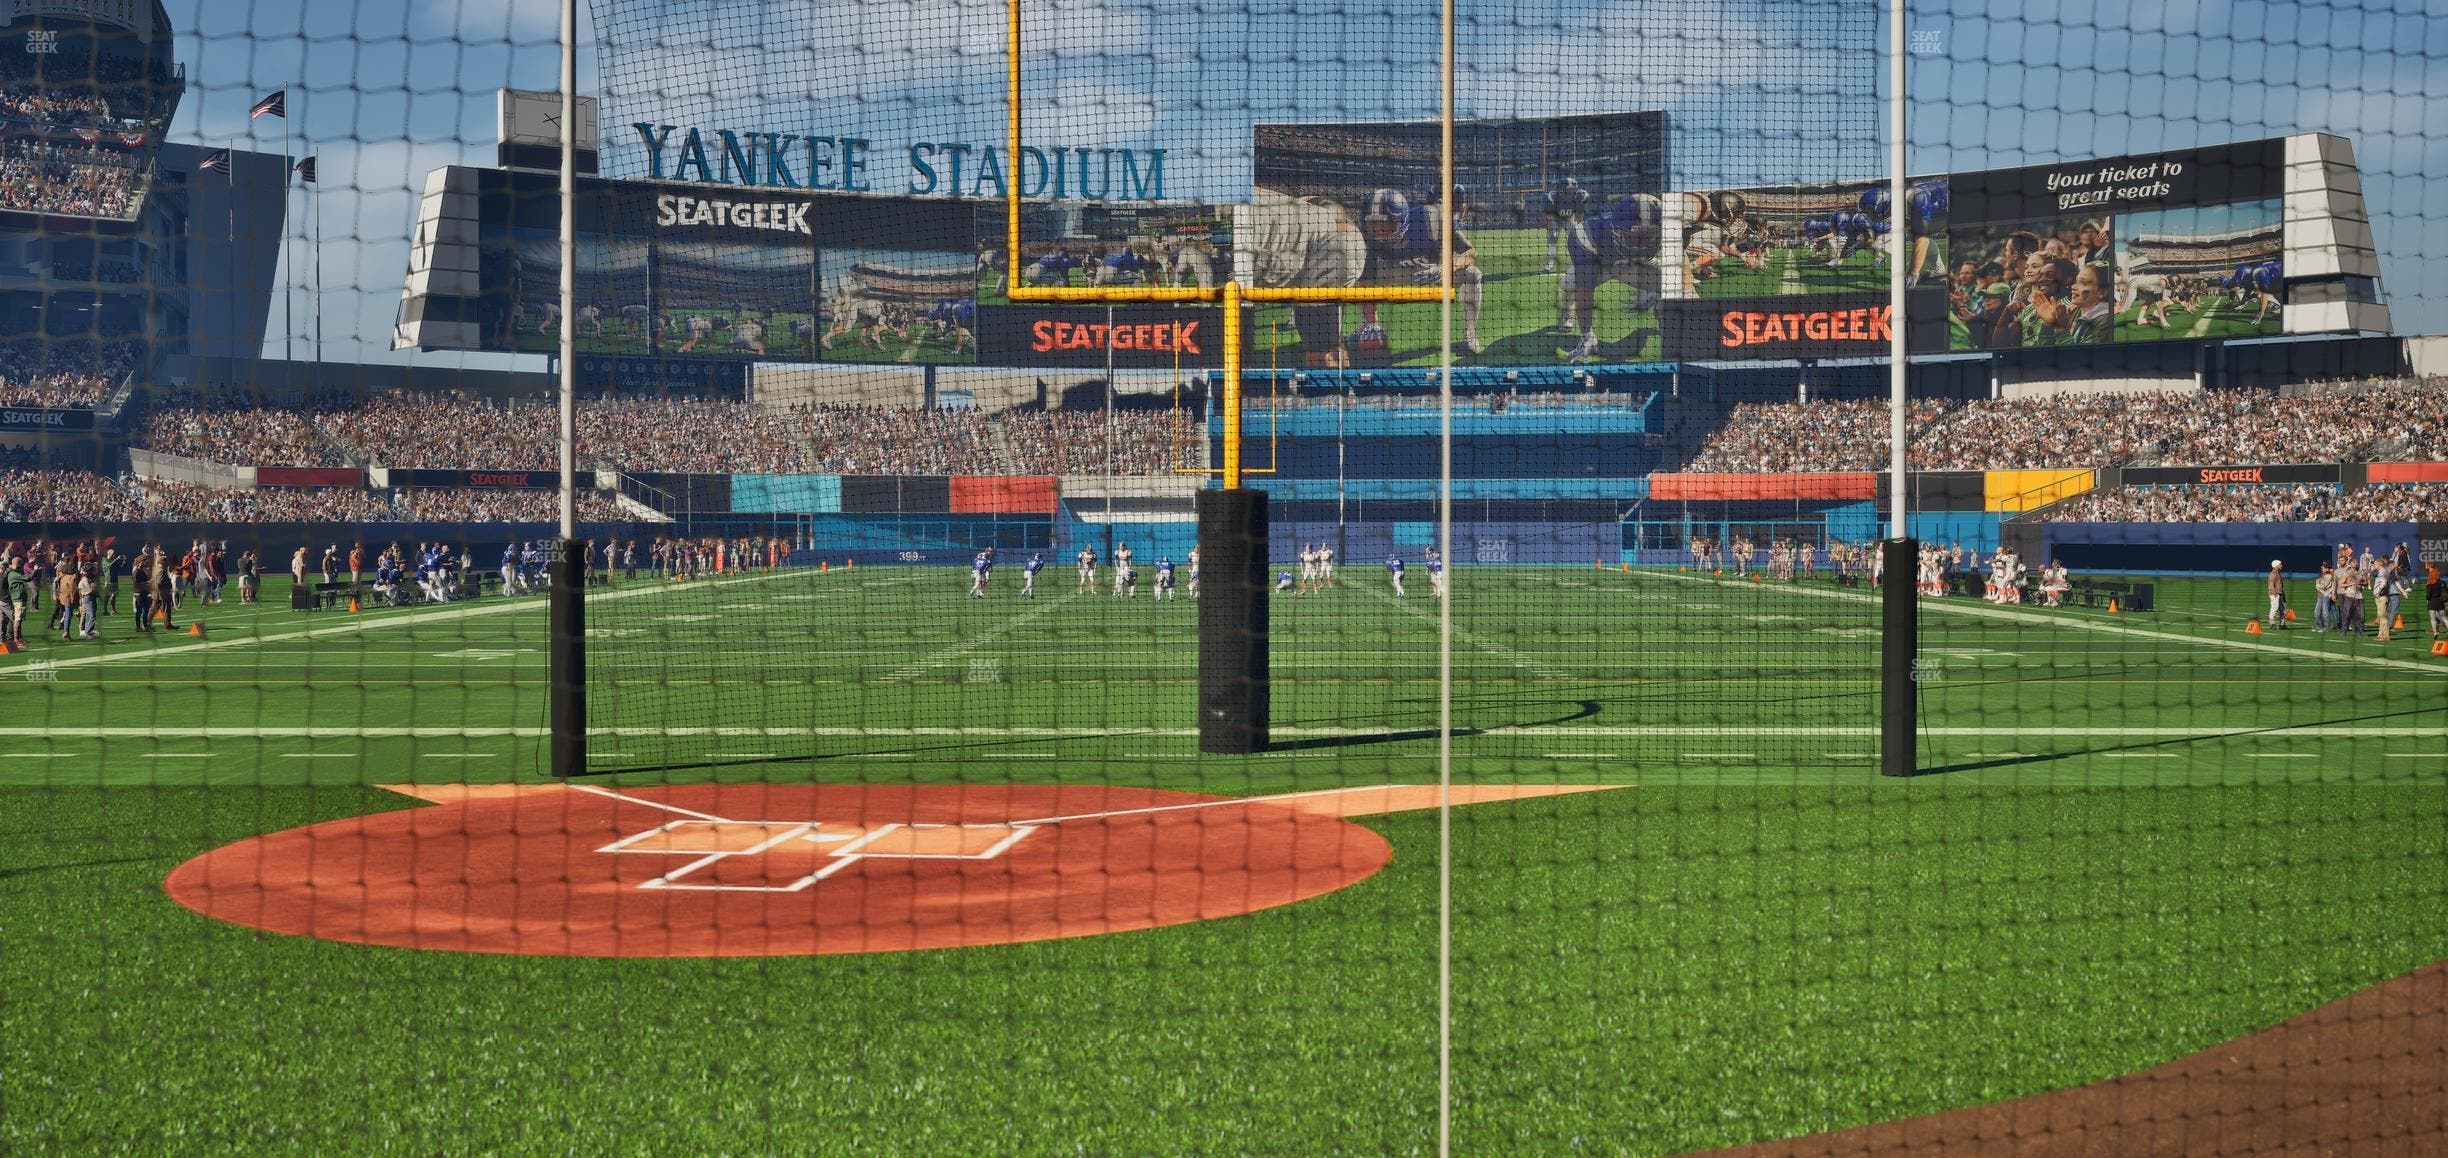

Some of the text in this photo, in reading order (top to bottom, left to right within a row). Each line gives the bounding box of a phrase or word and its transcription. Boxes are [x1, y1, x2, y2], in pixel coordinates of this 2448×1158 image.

[632, 122, 1168, 200] YANKEE STADIUM
[2047, 161, 2183, 192] Your ticket to
[2058, 181, 2171, 210] great seats
[656, 194, 813, 235] SEATGEEK
[1032, 319, 1200, 355] SEATGEEK
[1720, 304, 1892, 347] SEATGEEK
[3, 410, 65, 425] SEATGEEK
[470, 473, 529, 486] SEATGEEK
[2200, 466, 2263, 484] SEATGEEK
